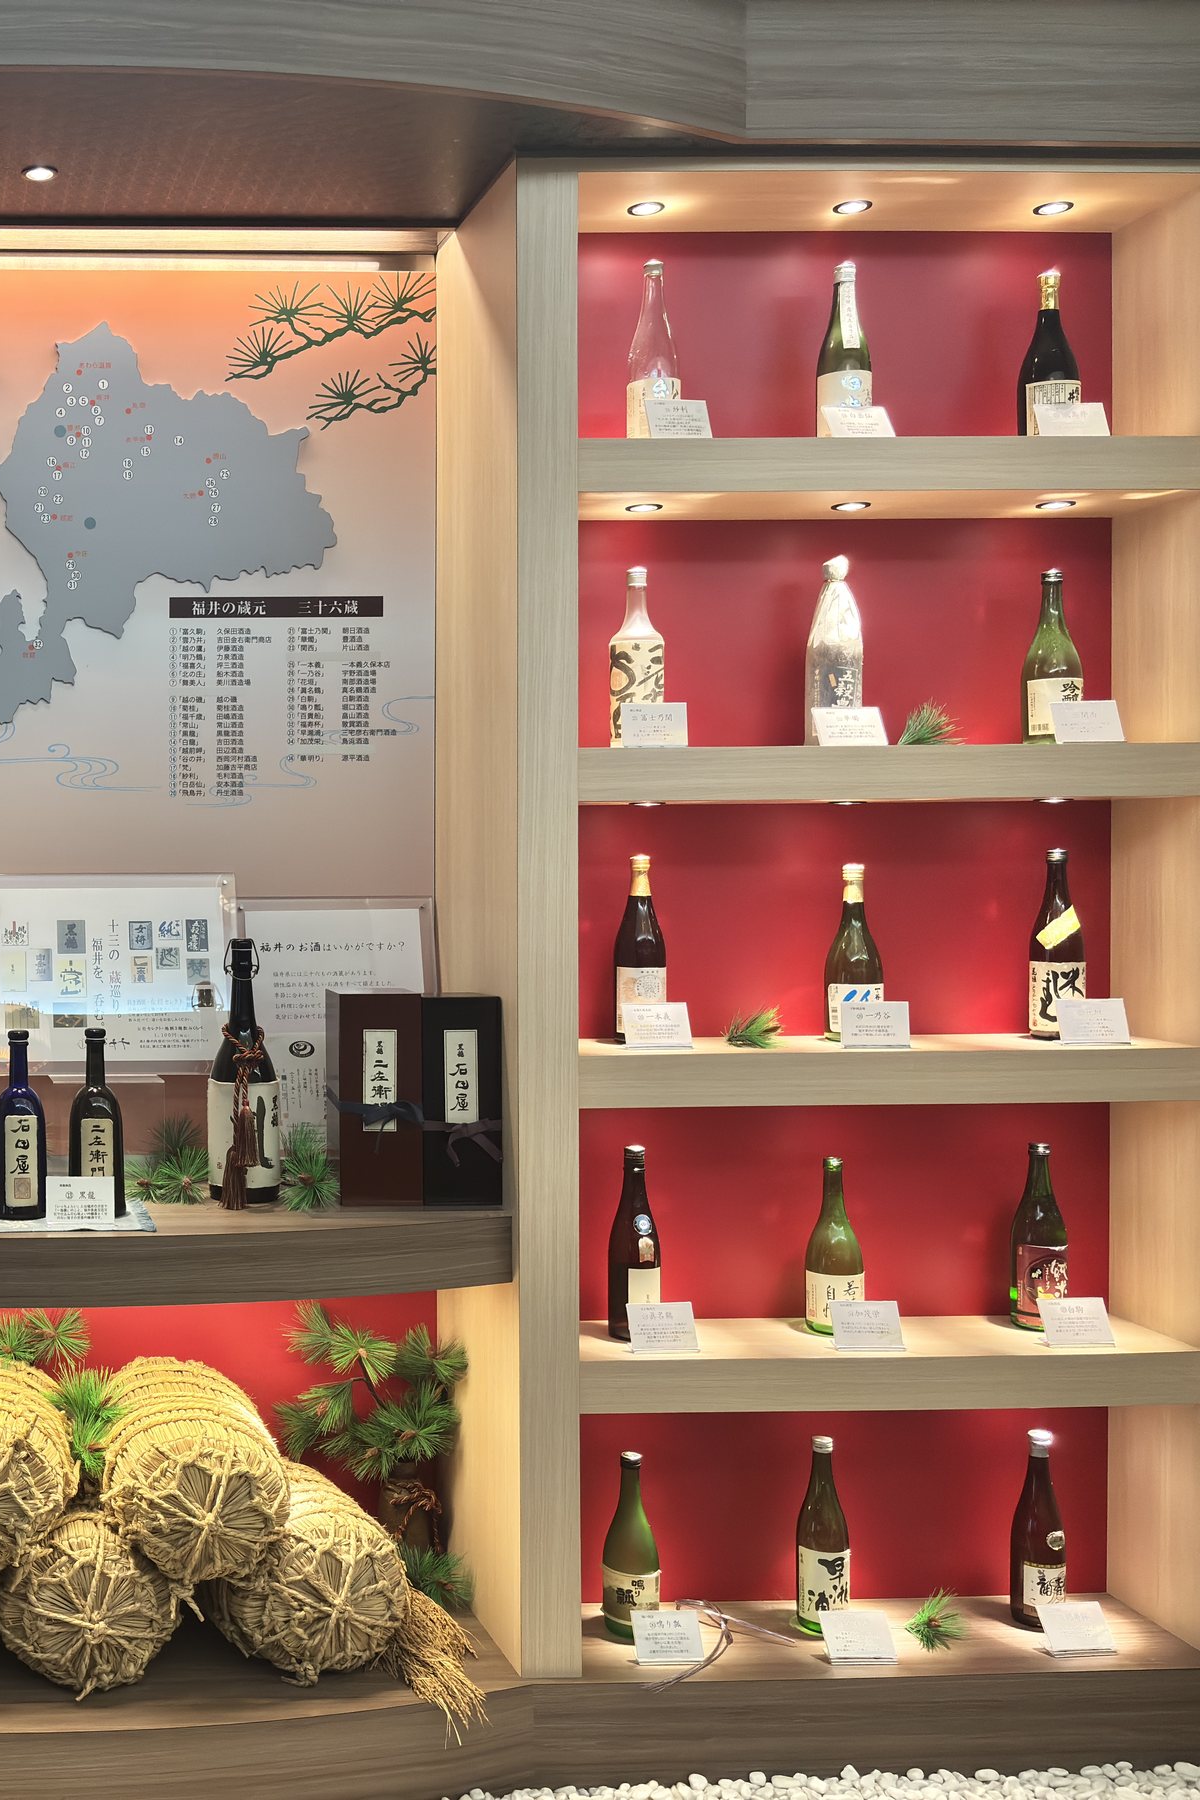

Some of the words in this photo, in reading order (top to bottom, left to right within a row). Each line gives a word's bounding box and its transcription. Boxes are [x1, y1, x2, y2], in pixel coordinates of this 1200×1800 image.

[192, 600, 267, 616] 福井の蔵元
[298, 600, 359, 615] 三十六蔵
[109, 919, 120, 960] 十三の
[449, 1063, 470, 1112] 石田屋
[10, 1119, 30, 1175] 石田屋
[88, 1125, 108, 1176] 二左衛門
